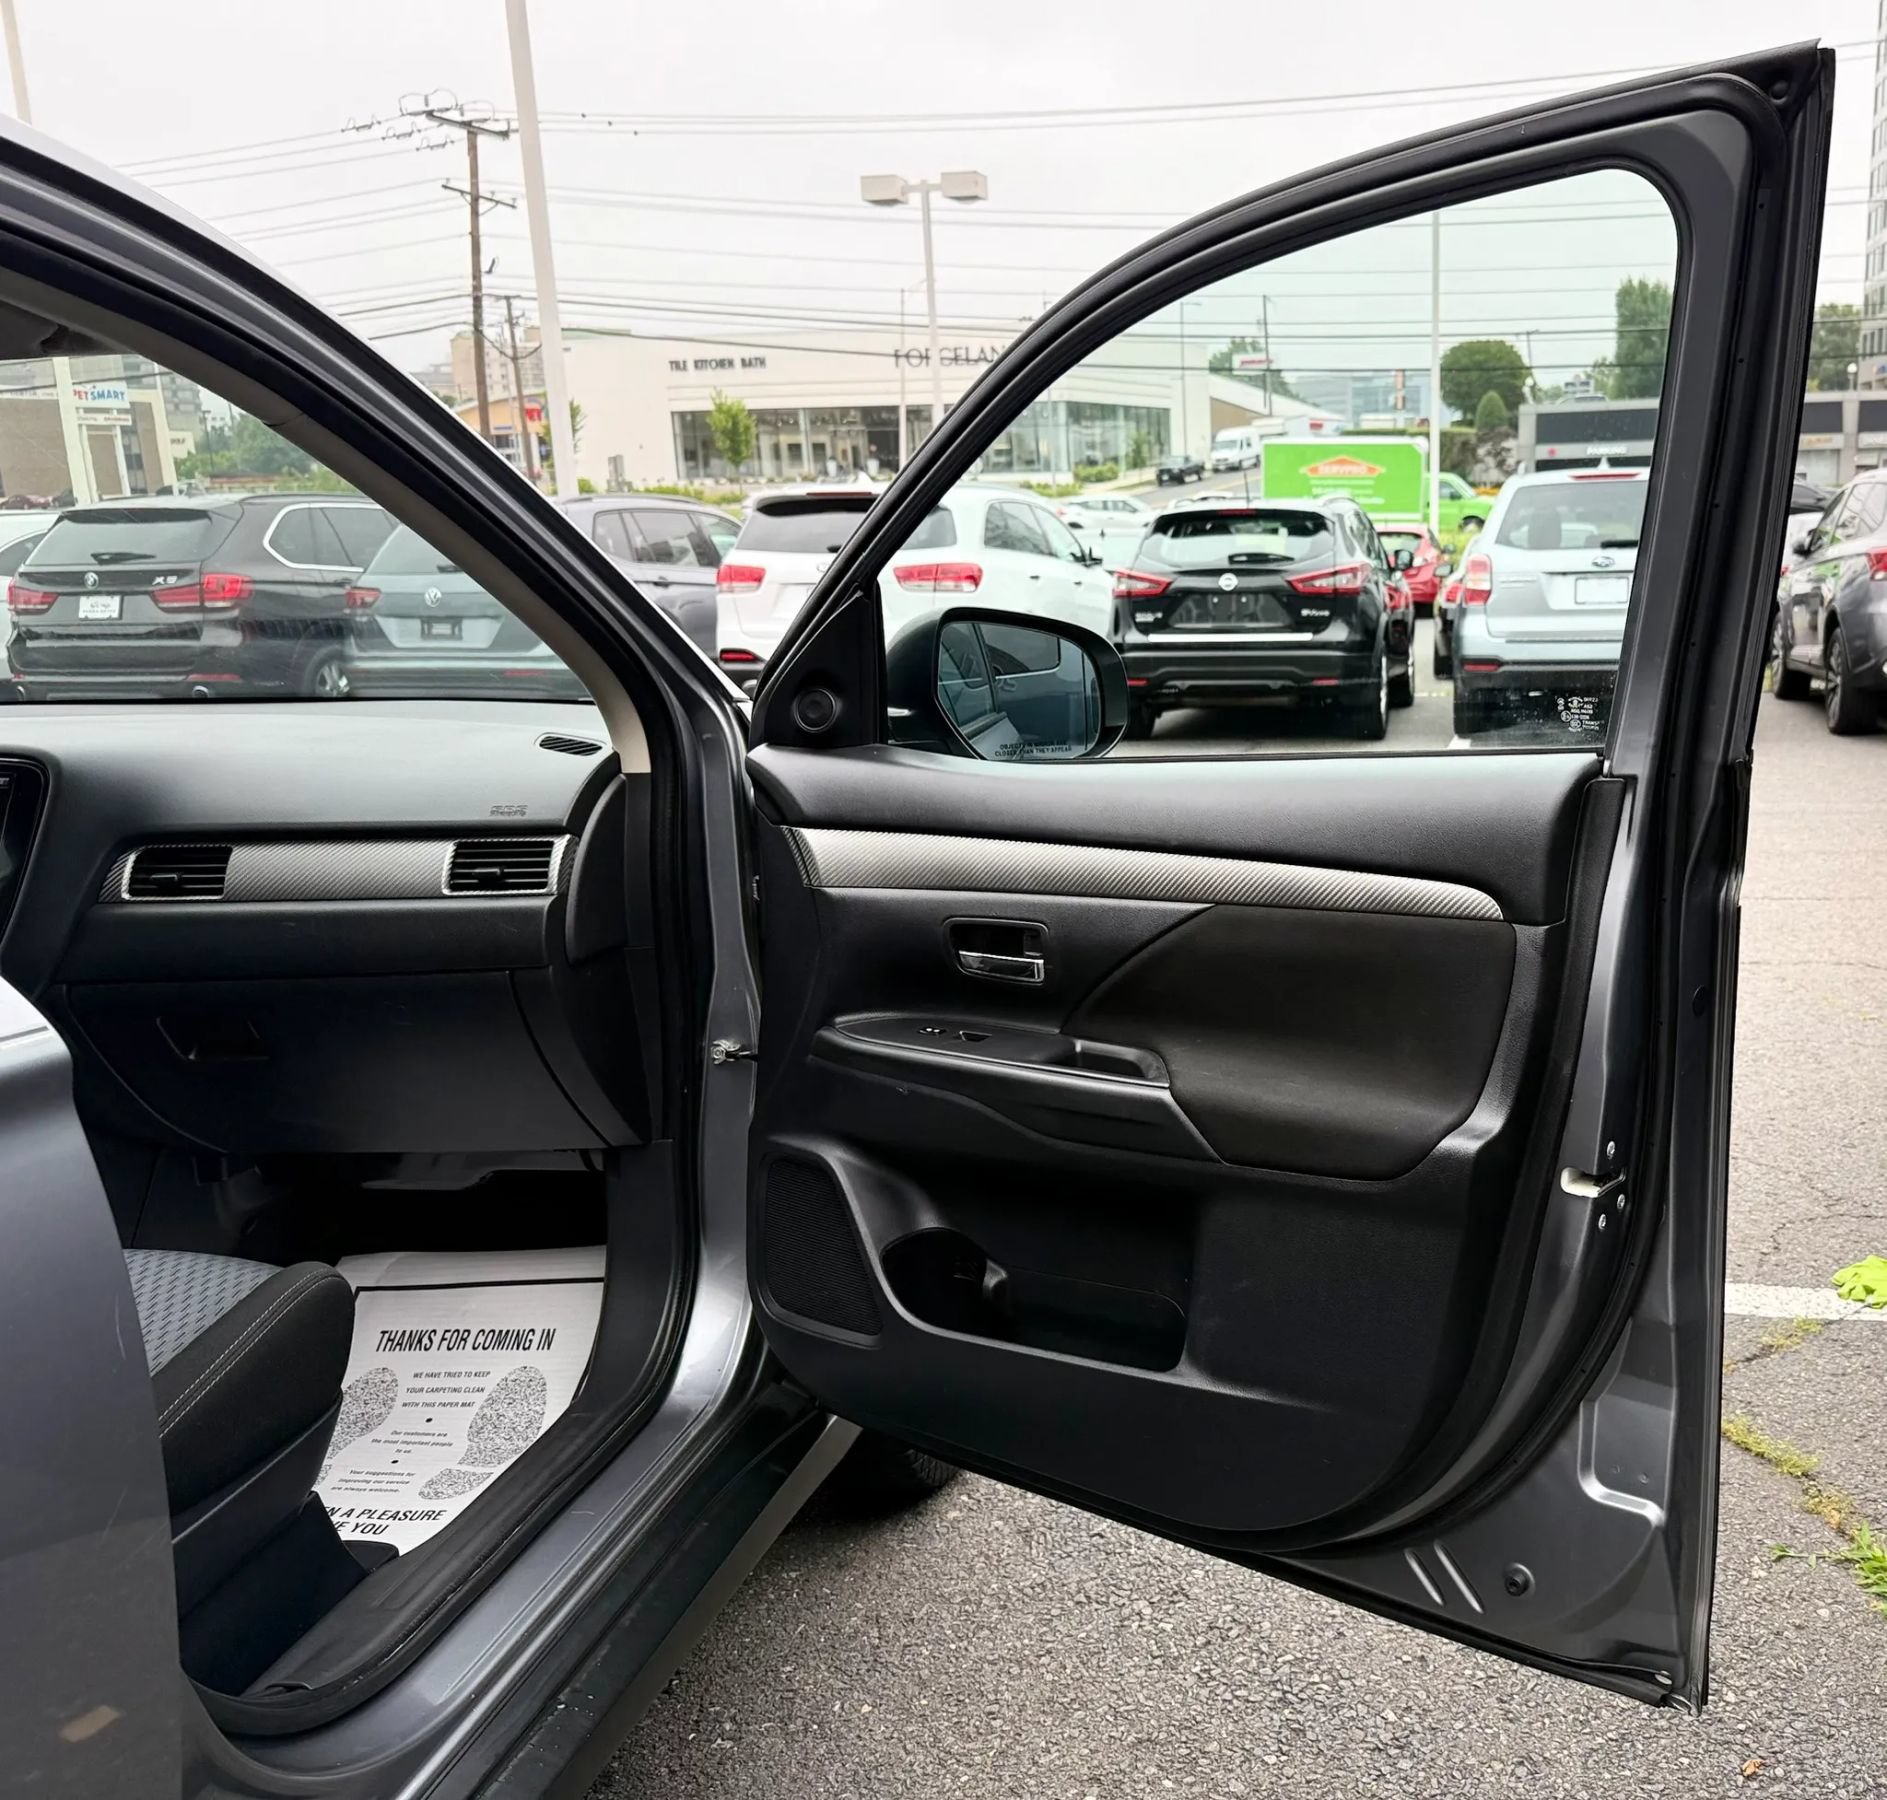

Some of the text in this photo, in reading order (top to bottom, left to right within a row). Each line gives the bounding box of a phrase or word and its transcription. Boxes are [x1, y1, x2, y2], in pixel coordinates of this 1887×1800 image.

[668, 357, 766, 372] TILE KITCHEN BATH
[152, 576, 177, 585] X5
[376, 1328, 557, 1352] THANKS FOR COMING IN
[413, 1371, 423, 1379] WE
[424, 1371, 441, 1379] HAVE
[406, 1386, 424, 1394] YOUR
[425, 1386, 462, 1394] CARPETING
[340, 1507, 355, 1518] A
[356, 1508, 447, 1521] PLEASURE
[351, 1522, 389, 1535] YOU
